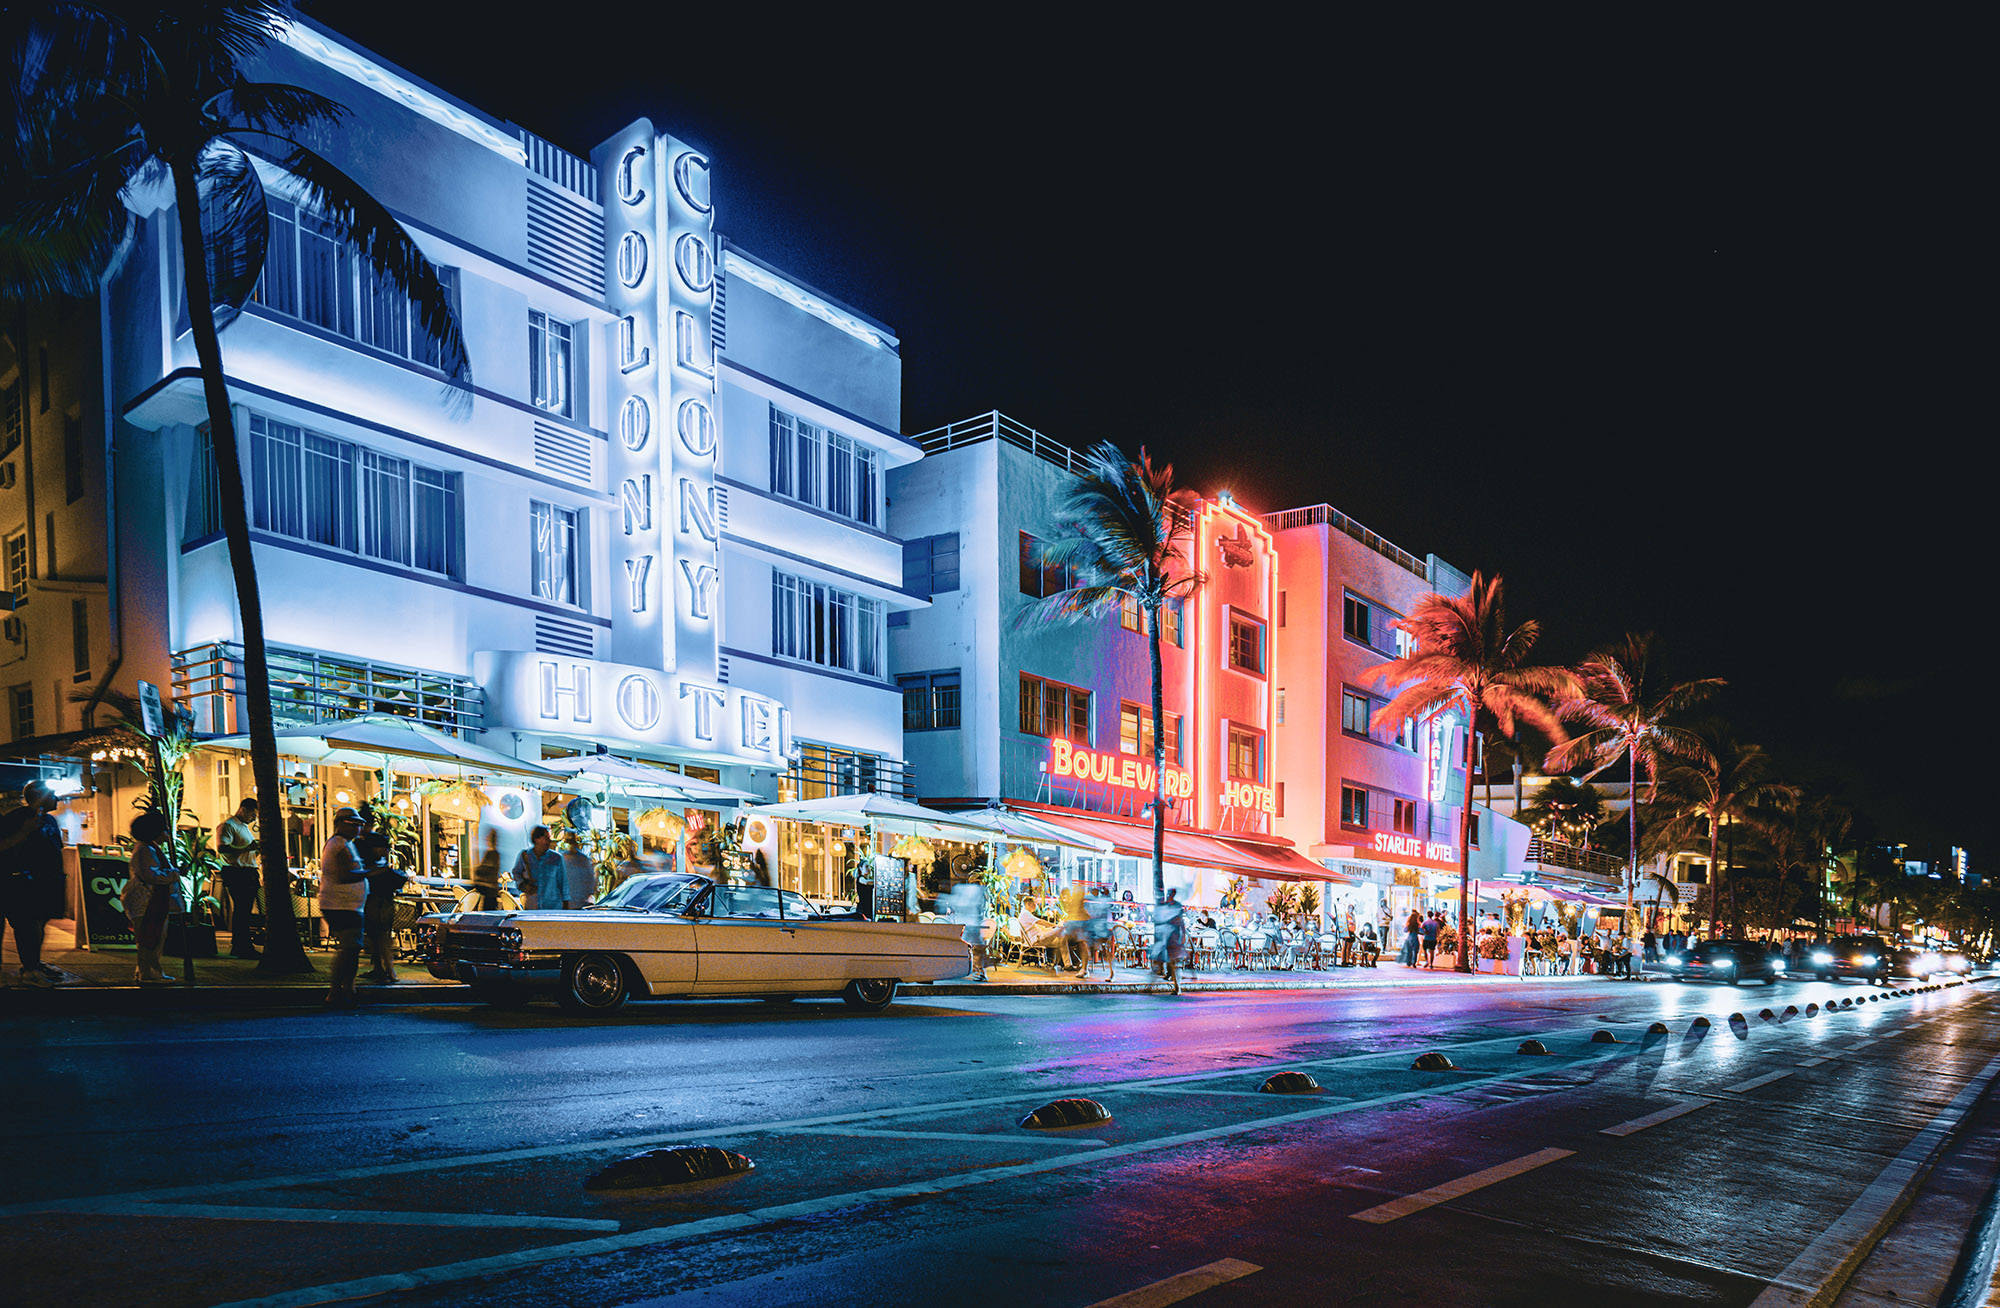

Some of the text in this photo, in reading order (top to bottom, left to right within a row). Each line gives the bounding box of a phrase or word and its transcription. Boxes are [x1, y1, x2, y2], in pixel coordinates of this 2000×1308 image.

[617, 145, 652, 613] COLONY
[673, 152, 716, 620] COLONY
[539, 661, 799, 760] HOTEL
[1430, 716, 1442, 801] STARLITE
[1225, 780, 1276, 814] HOTEL
[1374, 832, 1454, 863] STARLITE HOTEL
[91, 876, 128, 895] CV
[91, 933, 116, 941] Open
